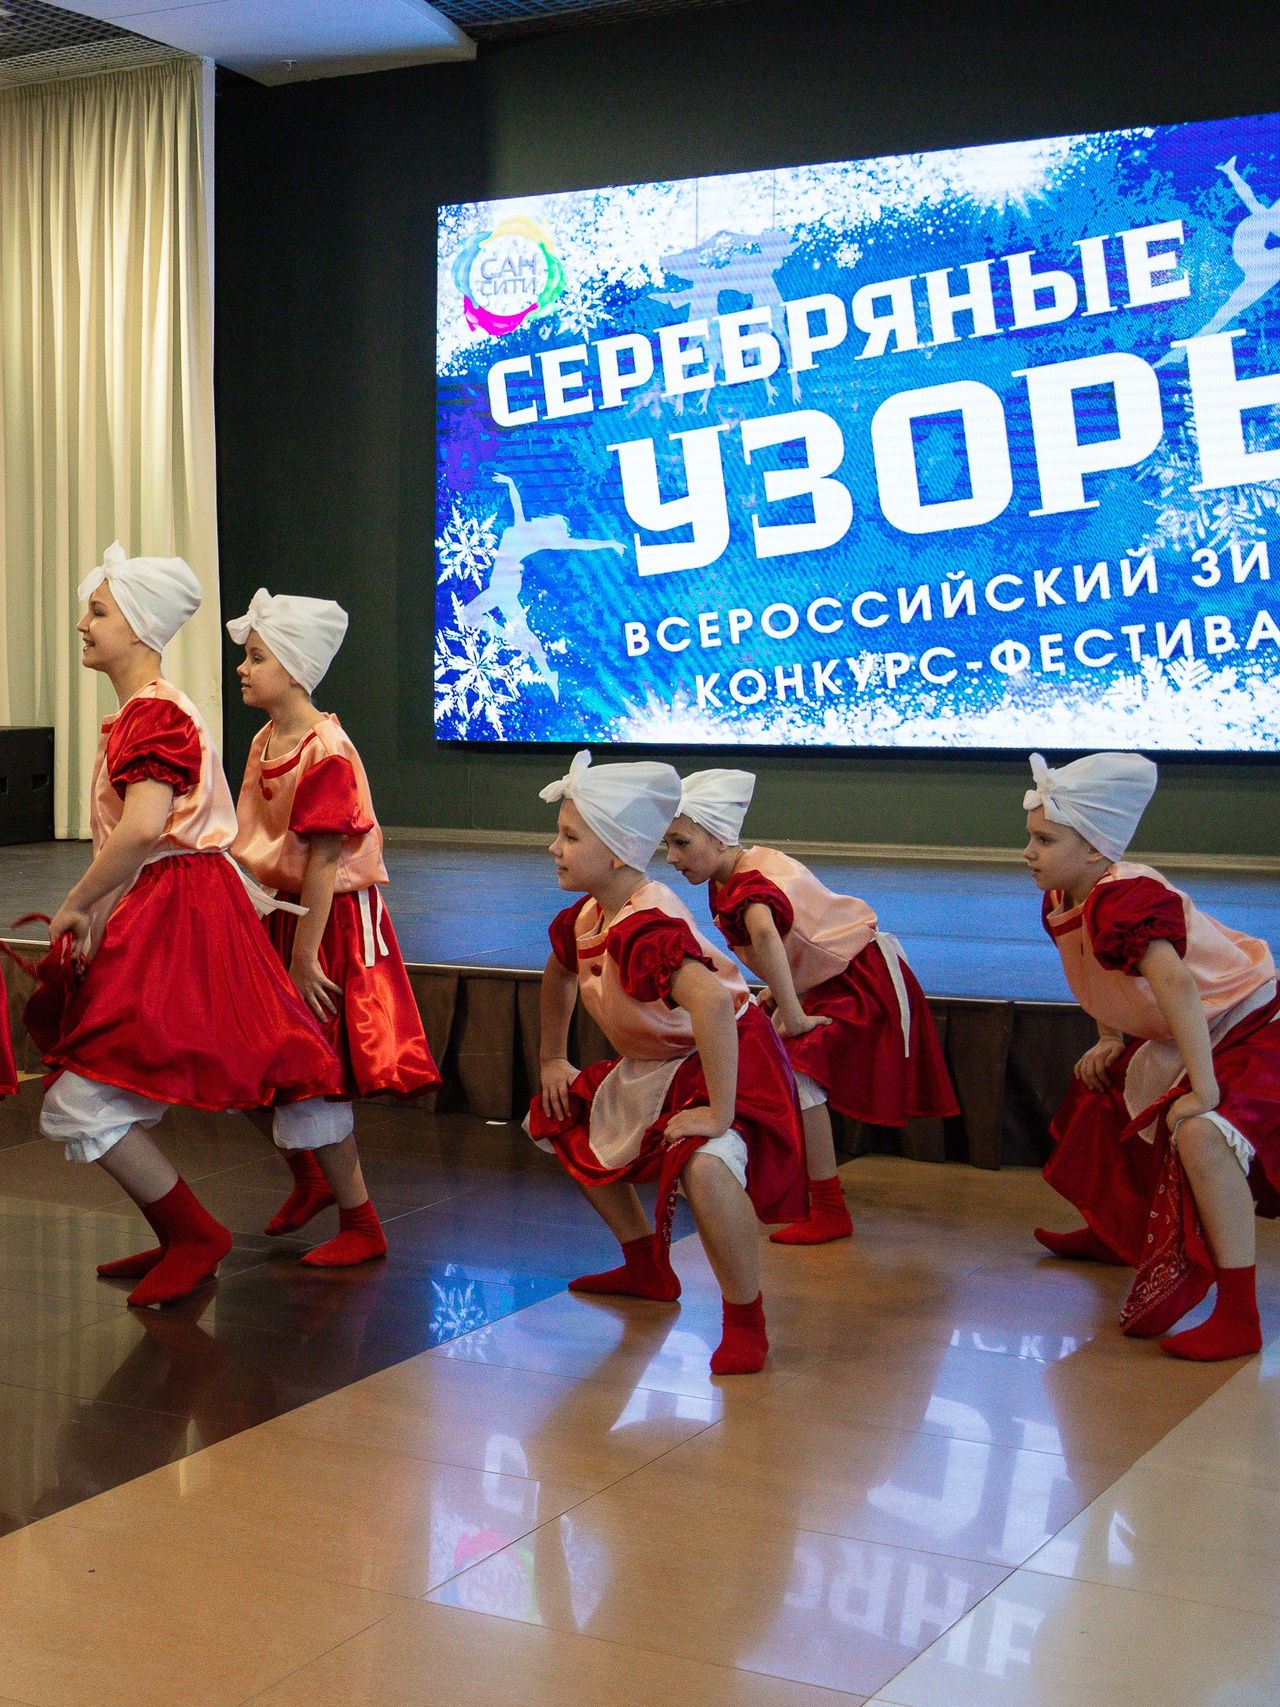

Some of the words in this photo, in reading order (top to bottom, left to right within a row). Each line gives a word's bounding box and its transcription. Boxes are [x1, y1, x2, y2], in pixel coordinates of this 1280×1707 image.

[480, 277, 537, 296] СИТИ
[481, 254, 537, 280] САН
[487, 219, 1190, 427] СЕРЕБРЯНЫЕ
[624, 546, 1158, 657] ВСЕРОССИЙСКИЙ
